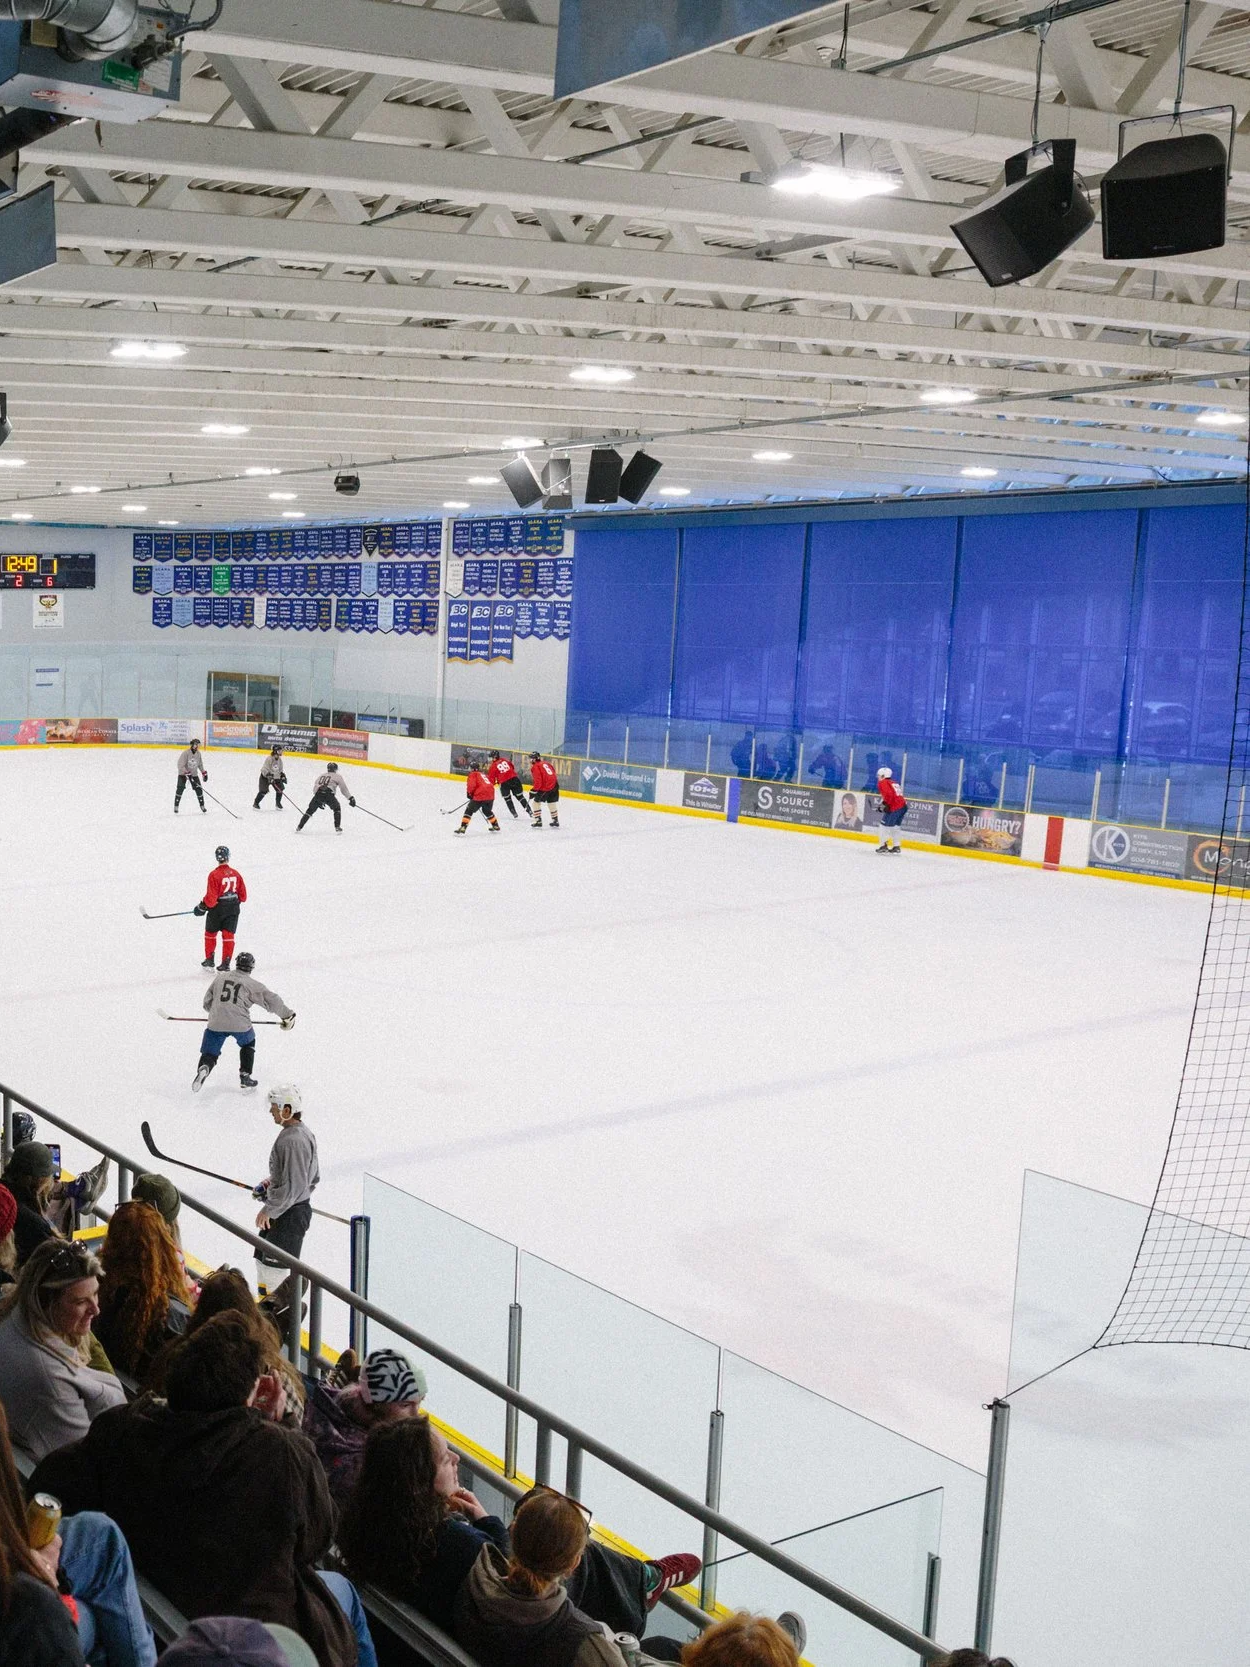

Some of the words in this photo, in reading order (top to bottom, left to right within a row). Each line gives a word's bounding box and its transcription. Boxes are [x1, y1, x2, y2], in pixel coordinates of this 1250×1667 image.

[7, 556, 37, 572] 12:49
[16, 576, 22, 587] 2
[47, 576, 52, 586] 6
[120, 722, 152, 732] Splash
[602, 770, 620, 780] Double
[621, 772, 643, 782] Diamond
[644, 774, 656, 784] Law
[782, 788, 810, 796] SQUAMISH
[701, 801, 722, 809] Whistler
[776, 795, 814, 808] SOURCE
[910, 802, 934, 812] SPINK
[790, 808, 810, 816] SPORTS
[972, 816, 1022, 835] HUNGRY?
[1132, 840, 1184, 851] CONSTRUCTION
[220, 980, 241, 1004] 51
